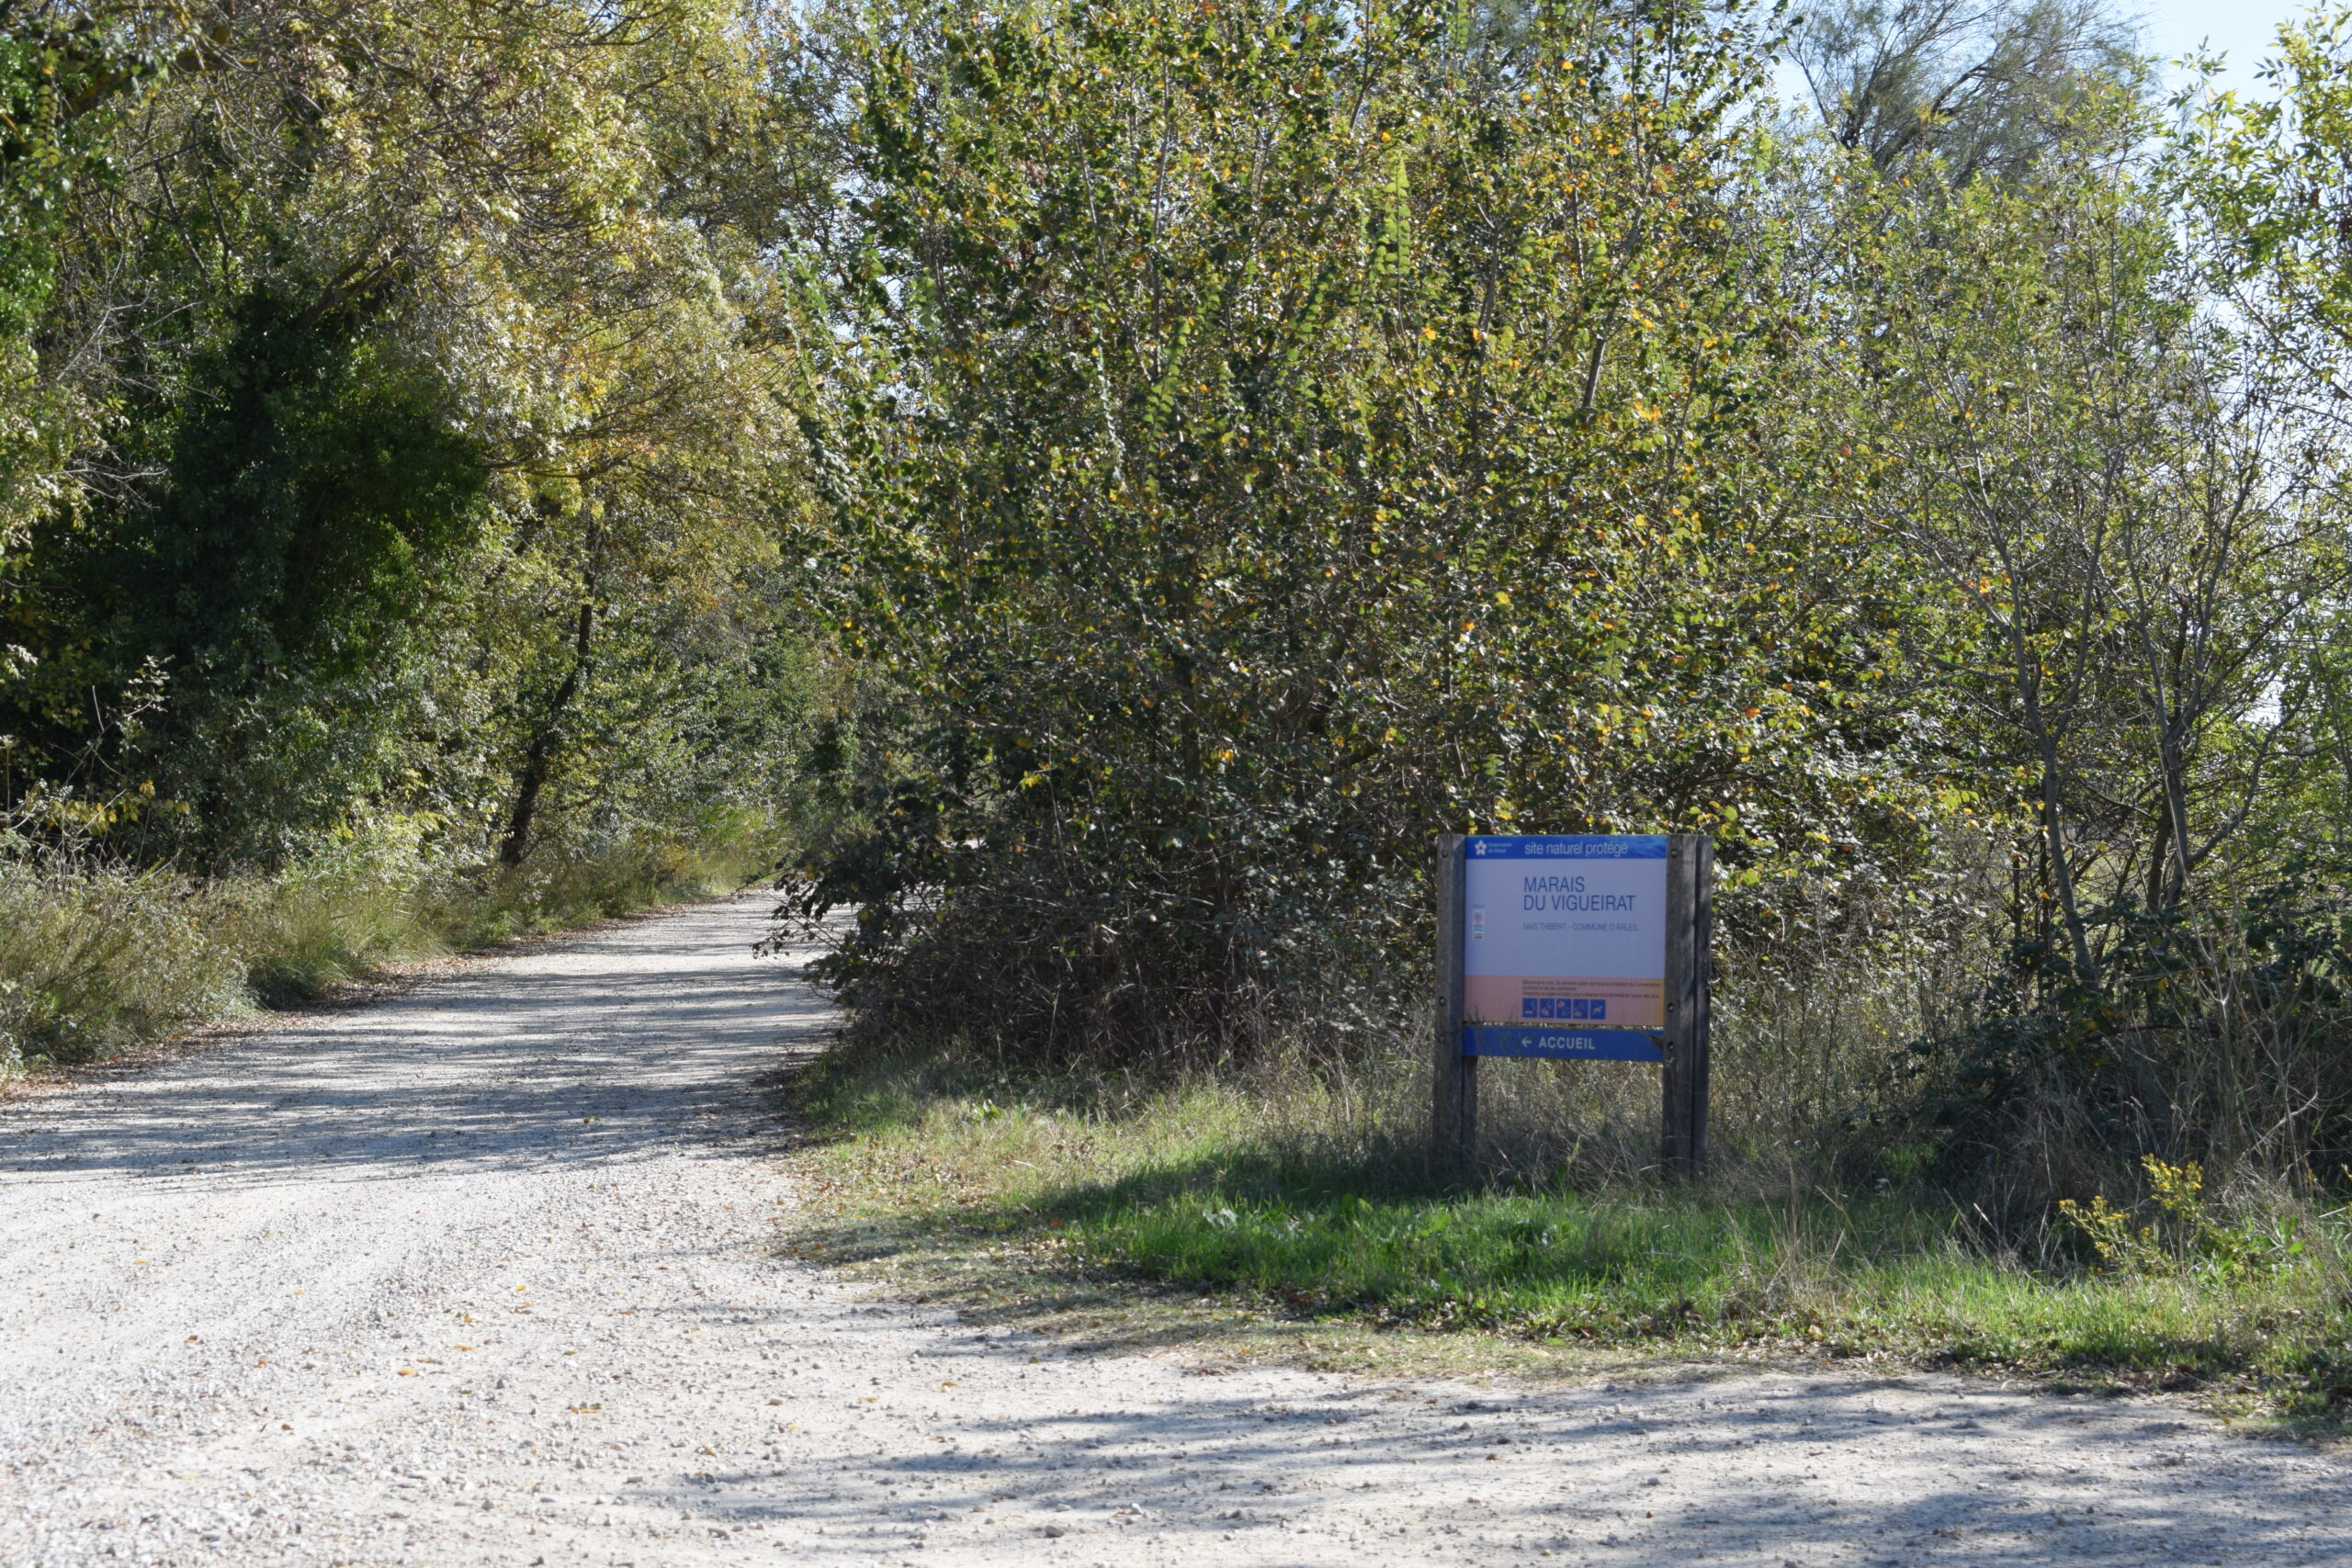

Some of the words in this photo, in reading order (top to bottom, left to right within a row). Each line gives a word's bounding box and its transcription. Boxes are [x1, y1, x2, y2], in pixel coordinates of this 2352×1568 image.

[1524, 841, 1544, 855] site
[1546, 840, 1582, 855] naturel
[1585, 840, 1628, 858] protégé
[1523, 875, 1585, 893] MARAIS
[1523, 895, 1546, 911] DU
[1550, 895, 1636, 912] VIGUEIRAT
[1523, 922, 1539, 931] MAS
[1539, 922, 1566, 931] THIBERT
[1572, 922, 1608, 932] COMMUNE
[1608, 923, 1638, 932] D'ARLES
[1538, 1036, 1596, 1050] ACCUEIL
